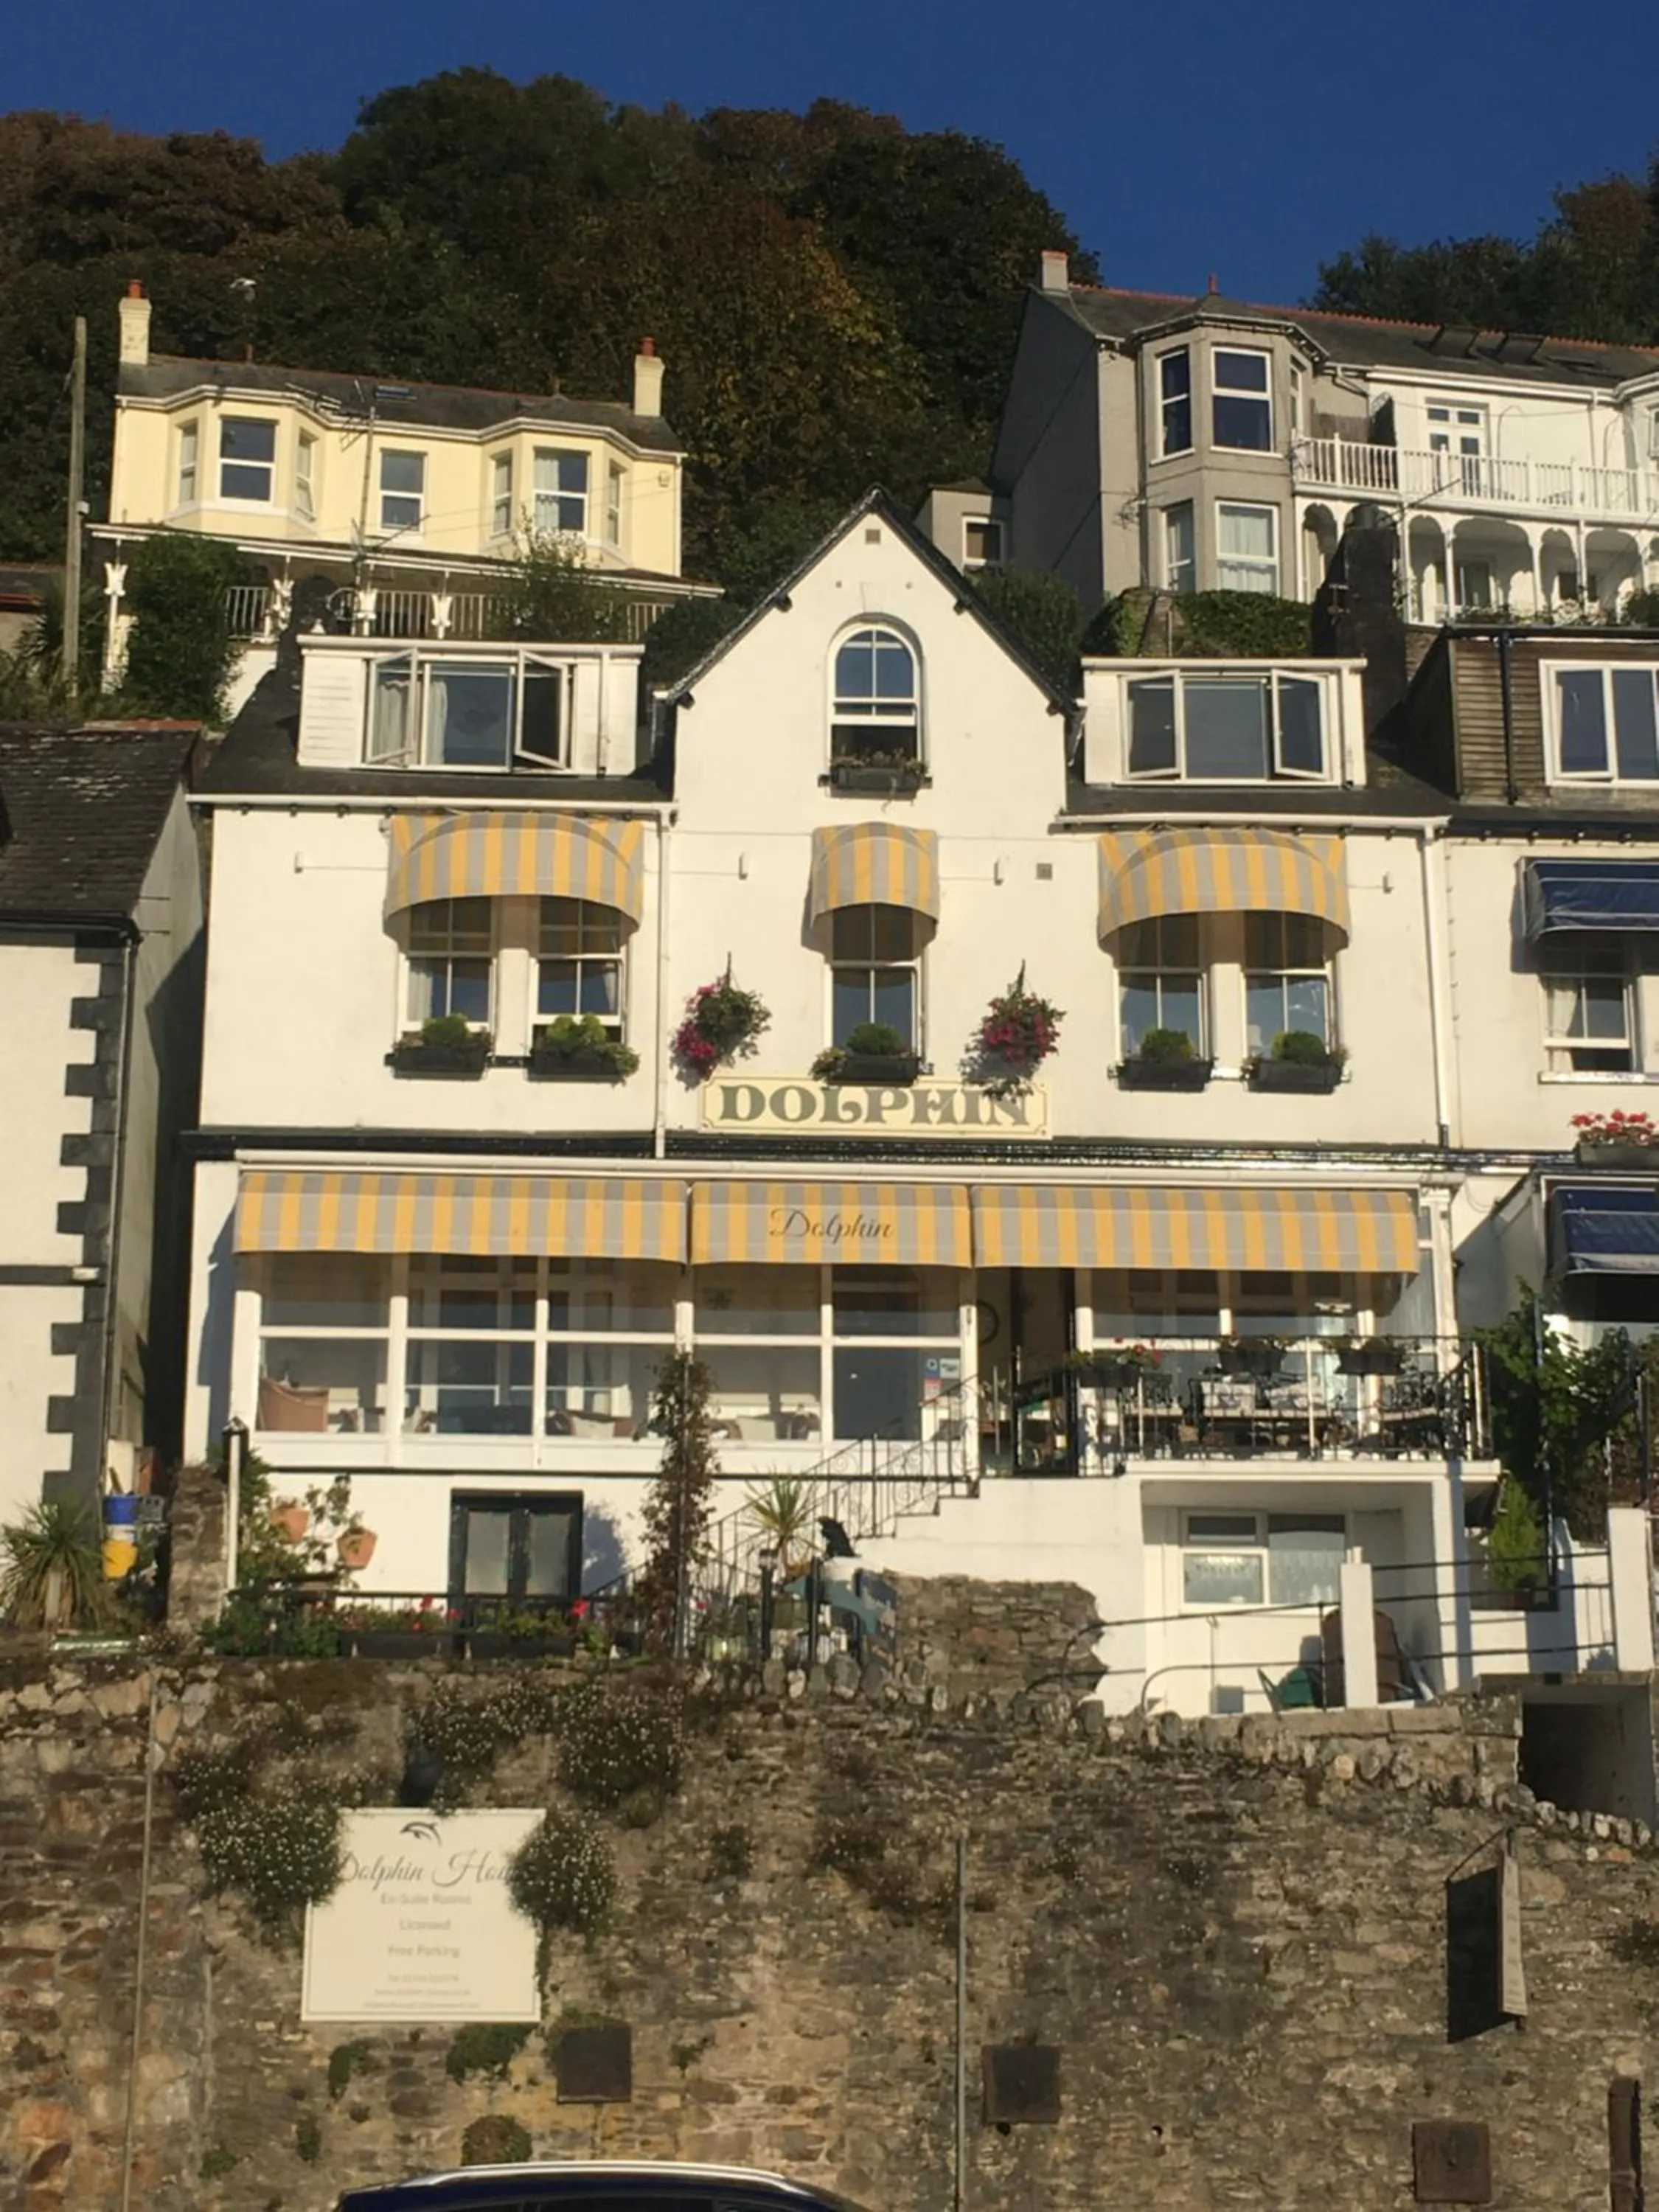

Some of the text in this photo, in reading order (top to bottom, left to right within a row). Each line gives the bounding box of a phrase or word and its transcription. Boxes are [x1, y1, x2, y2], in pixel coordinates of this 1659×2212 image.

[719, 1084, 1029, 1127] DOLPHIN
[768, 1207, 893, 1245] Dolphin
[338, 1851, 424, 1891] Dolphin
